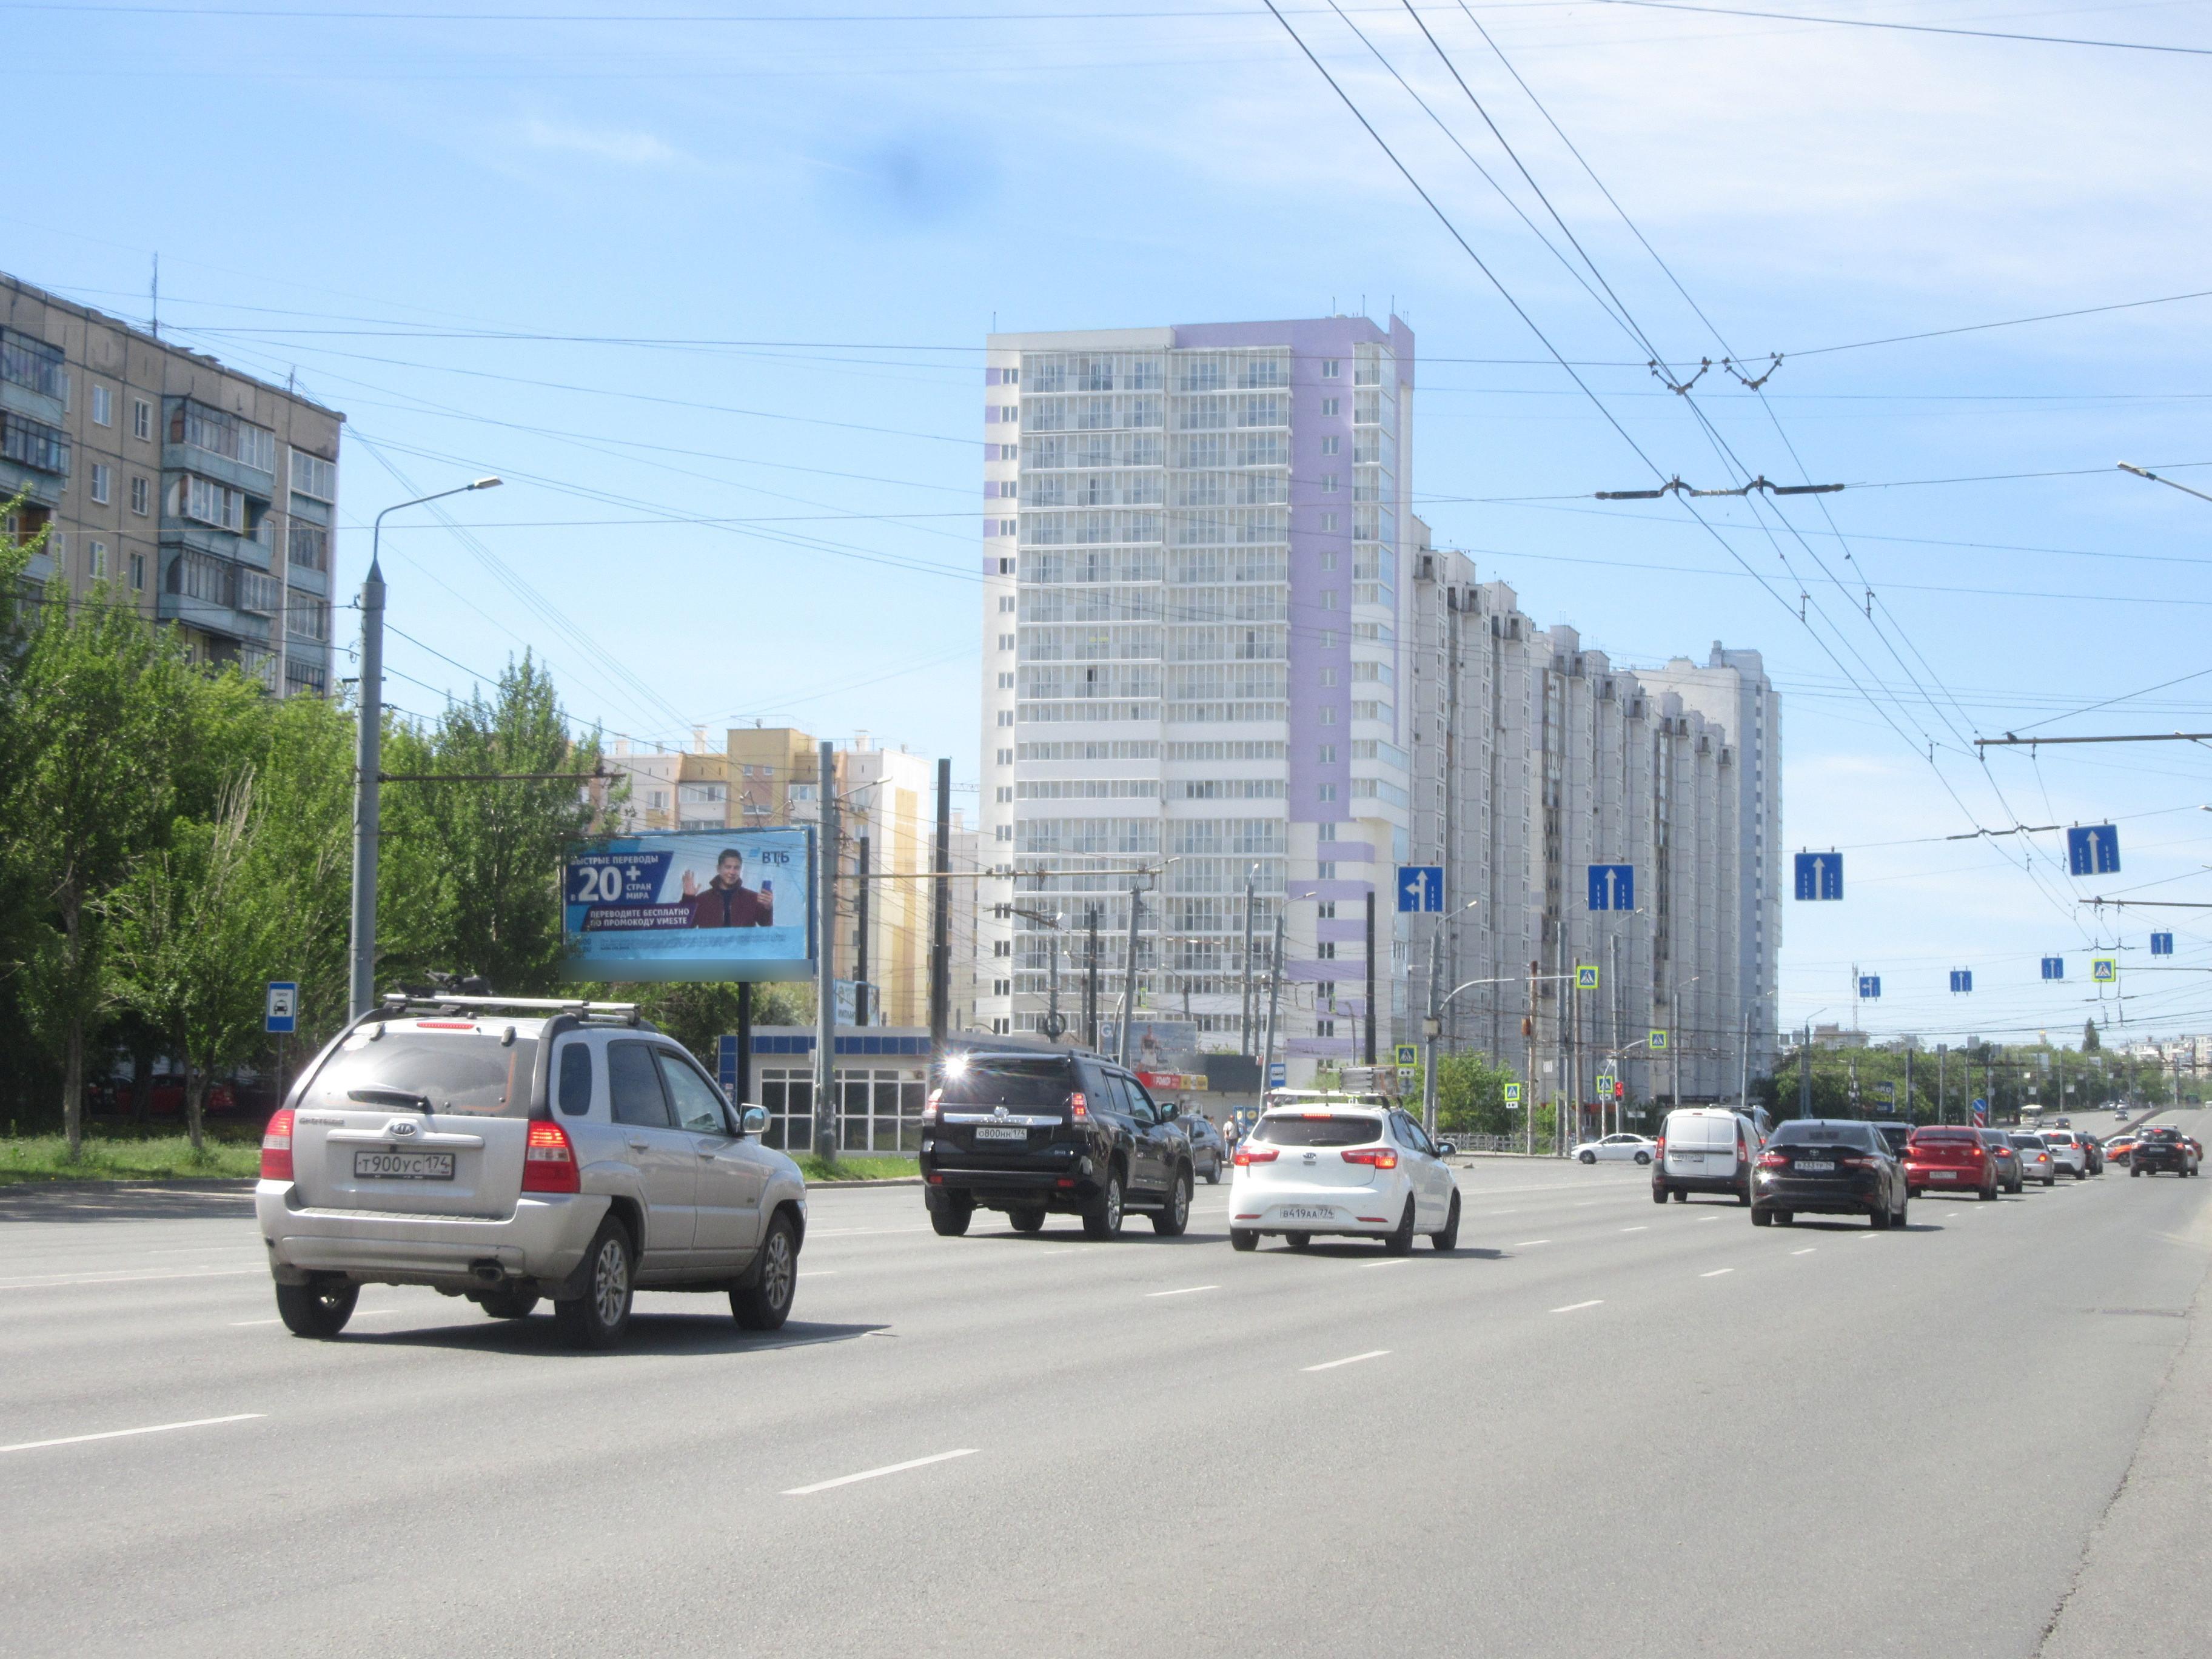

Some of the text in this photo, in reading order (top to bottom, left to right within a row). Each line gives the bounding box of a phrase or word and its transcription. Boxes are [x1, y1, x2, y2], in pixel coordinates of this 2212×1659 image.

[612, 856, 659, 865] ПЕРЕВОДЫ
[762, 850, 790, 864] ВТБ
[626, 883, 652, 891] СТРАН
[590, 908, 689, 919] ПЕРЕВОДИТЕ БЕСПЛАТНО
[604, 918, 654, 927] ПРОМОКОДУ
[657, 916, 687, 925] VMESTE
[392, 1124, 415, 1134] KIA
